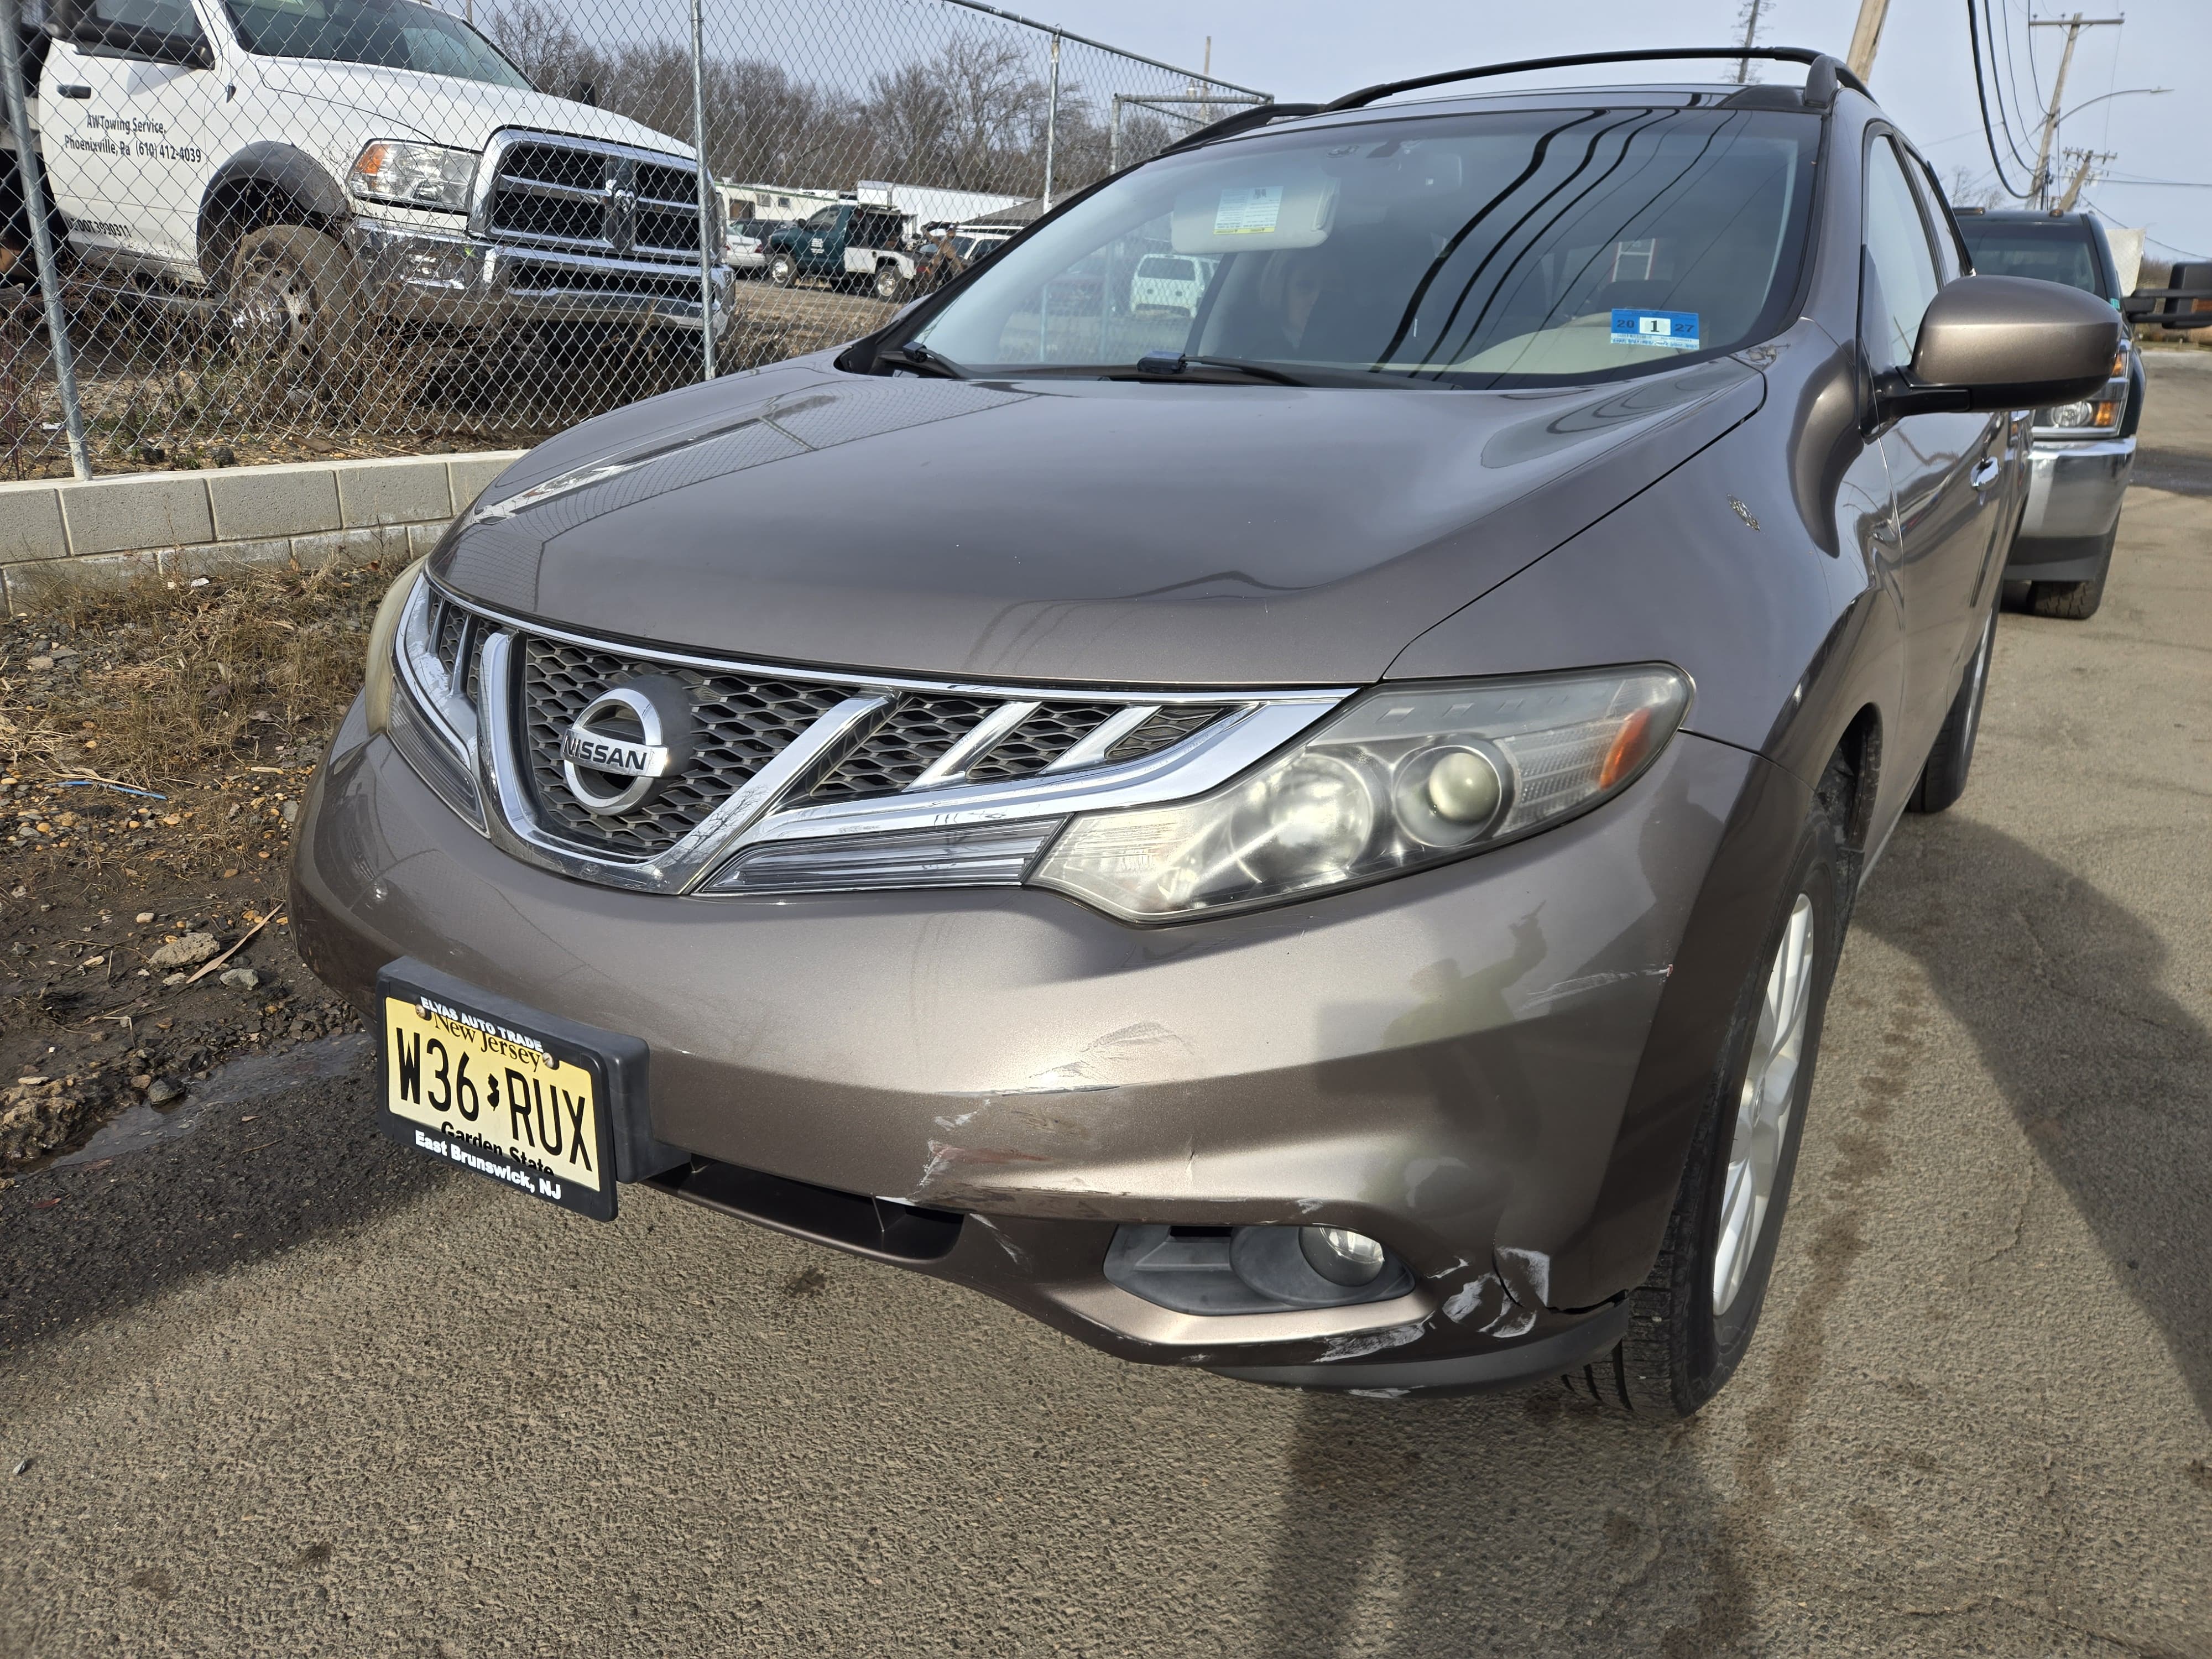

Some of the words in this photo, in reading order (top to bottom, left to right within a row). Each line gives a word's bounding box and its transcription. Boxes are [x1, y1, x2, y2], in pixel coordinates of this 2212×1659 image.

[64, 135, 118, 156] Phoenixville,
[120, 140, 131, 155] Pa
[136, 140, 158, 160] (610)
[1616, 319, 1635, 328] 20
[1650, 320, 1660, 333] 1
[1674, 324, 1695, 332] 27
[562, 735, 647, 770] NISSAN
[420, 996, 459, 1021] ELYAS
[461, 1013, 496, 1035] AUTO
[497, 1026, 544, 1053] TRADE
[434, 1013, 476, 1044] New
[481, 1031, 541, 1073] Jersey
[396, 1027, 479, 1122] W36
[504, 1067, 593, 1172] RUX
[415, 1129, 447, 1156] East
[450, 1144, 535, 1193] Brunswick,
[539, 1178, 561, 1199] NJ
[441, 1121, 503, 1156] Garden
[509, 1146, 554, 1177] State
